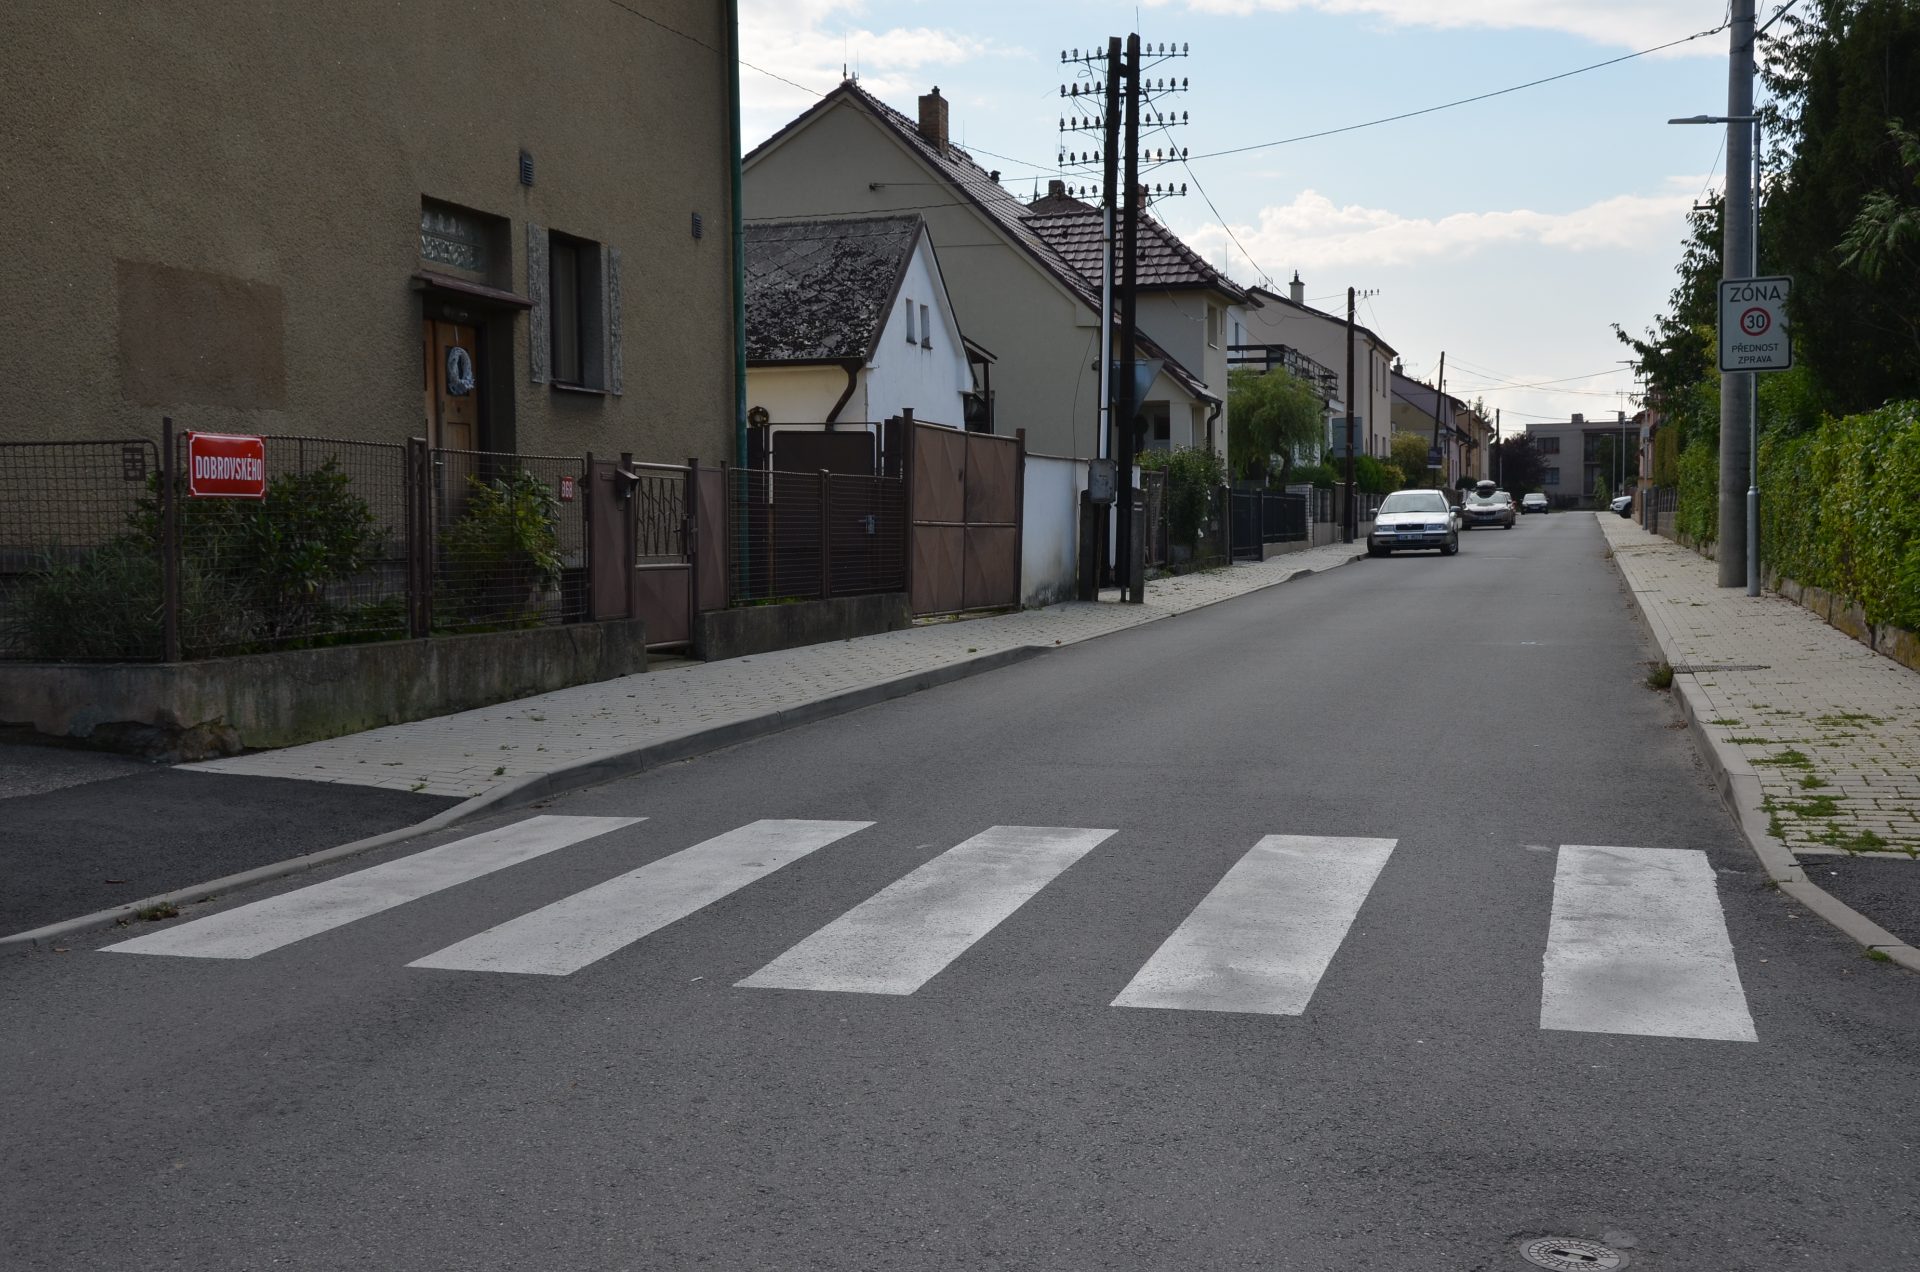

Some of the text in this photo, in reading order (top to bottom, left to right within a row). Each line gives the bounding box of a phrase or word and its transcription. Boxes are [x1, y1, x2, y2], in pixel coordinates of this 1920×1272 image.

[1729, 283, 1781, 302] ZÓNA
[1746, 314, 1765, 329] 30
[1731, 342, 1779, 353] PŘEDNOST
[1738, 355, 1772, 365] ZPRAVA
[195, 453, 262, 481] DOBROVSKÉHO
